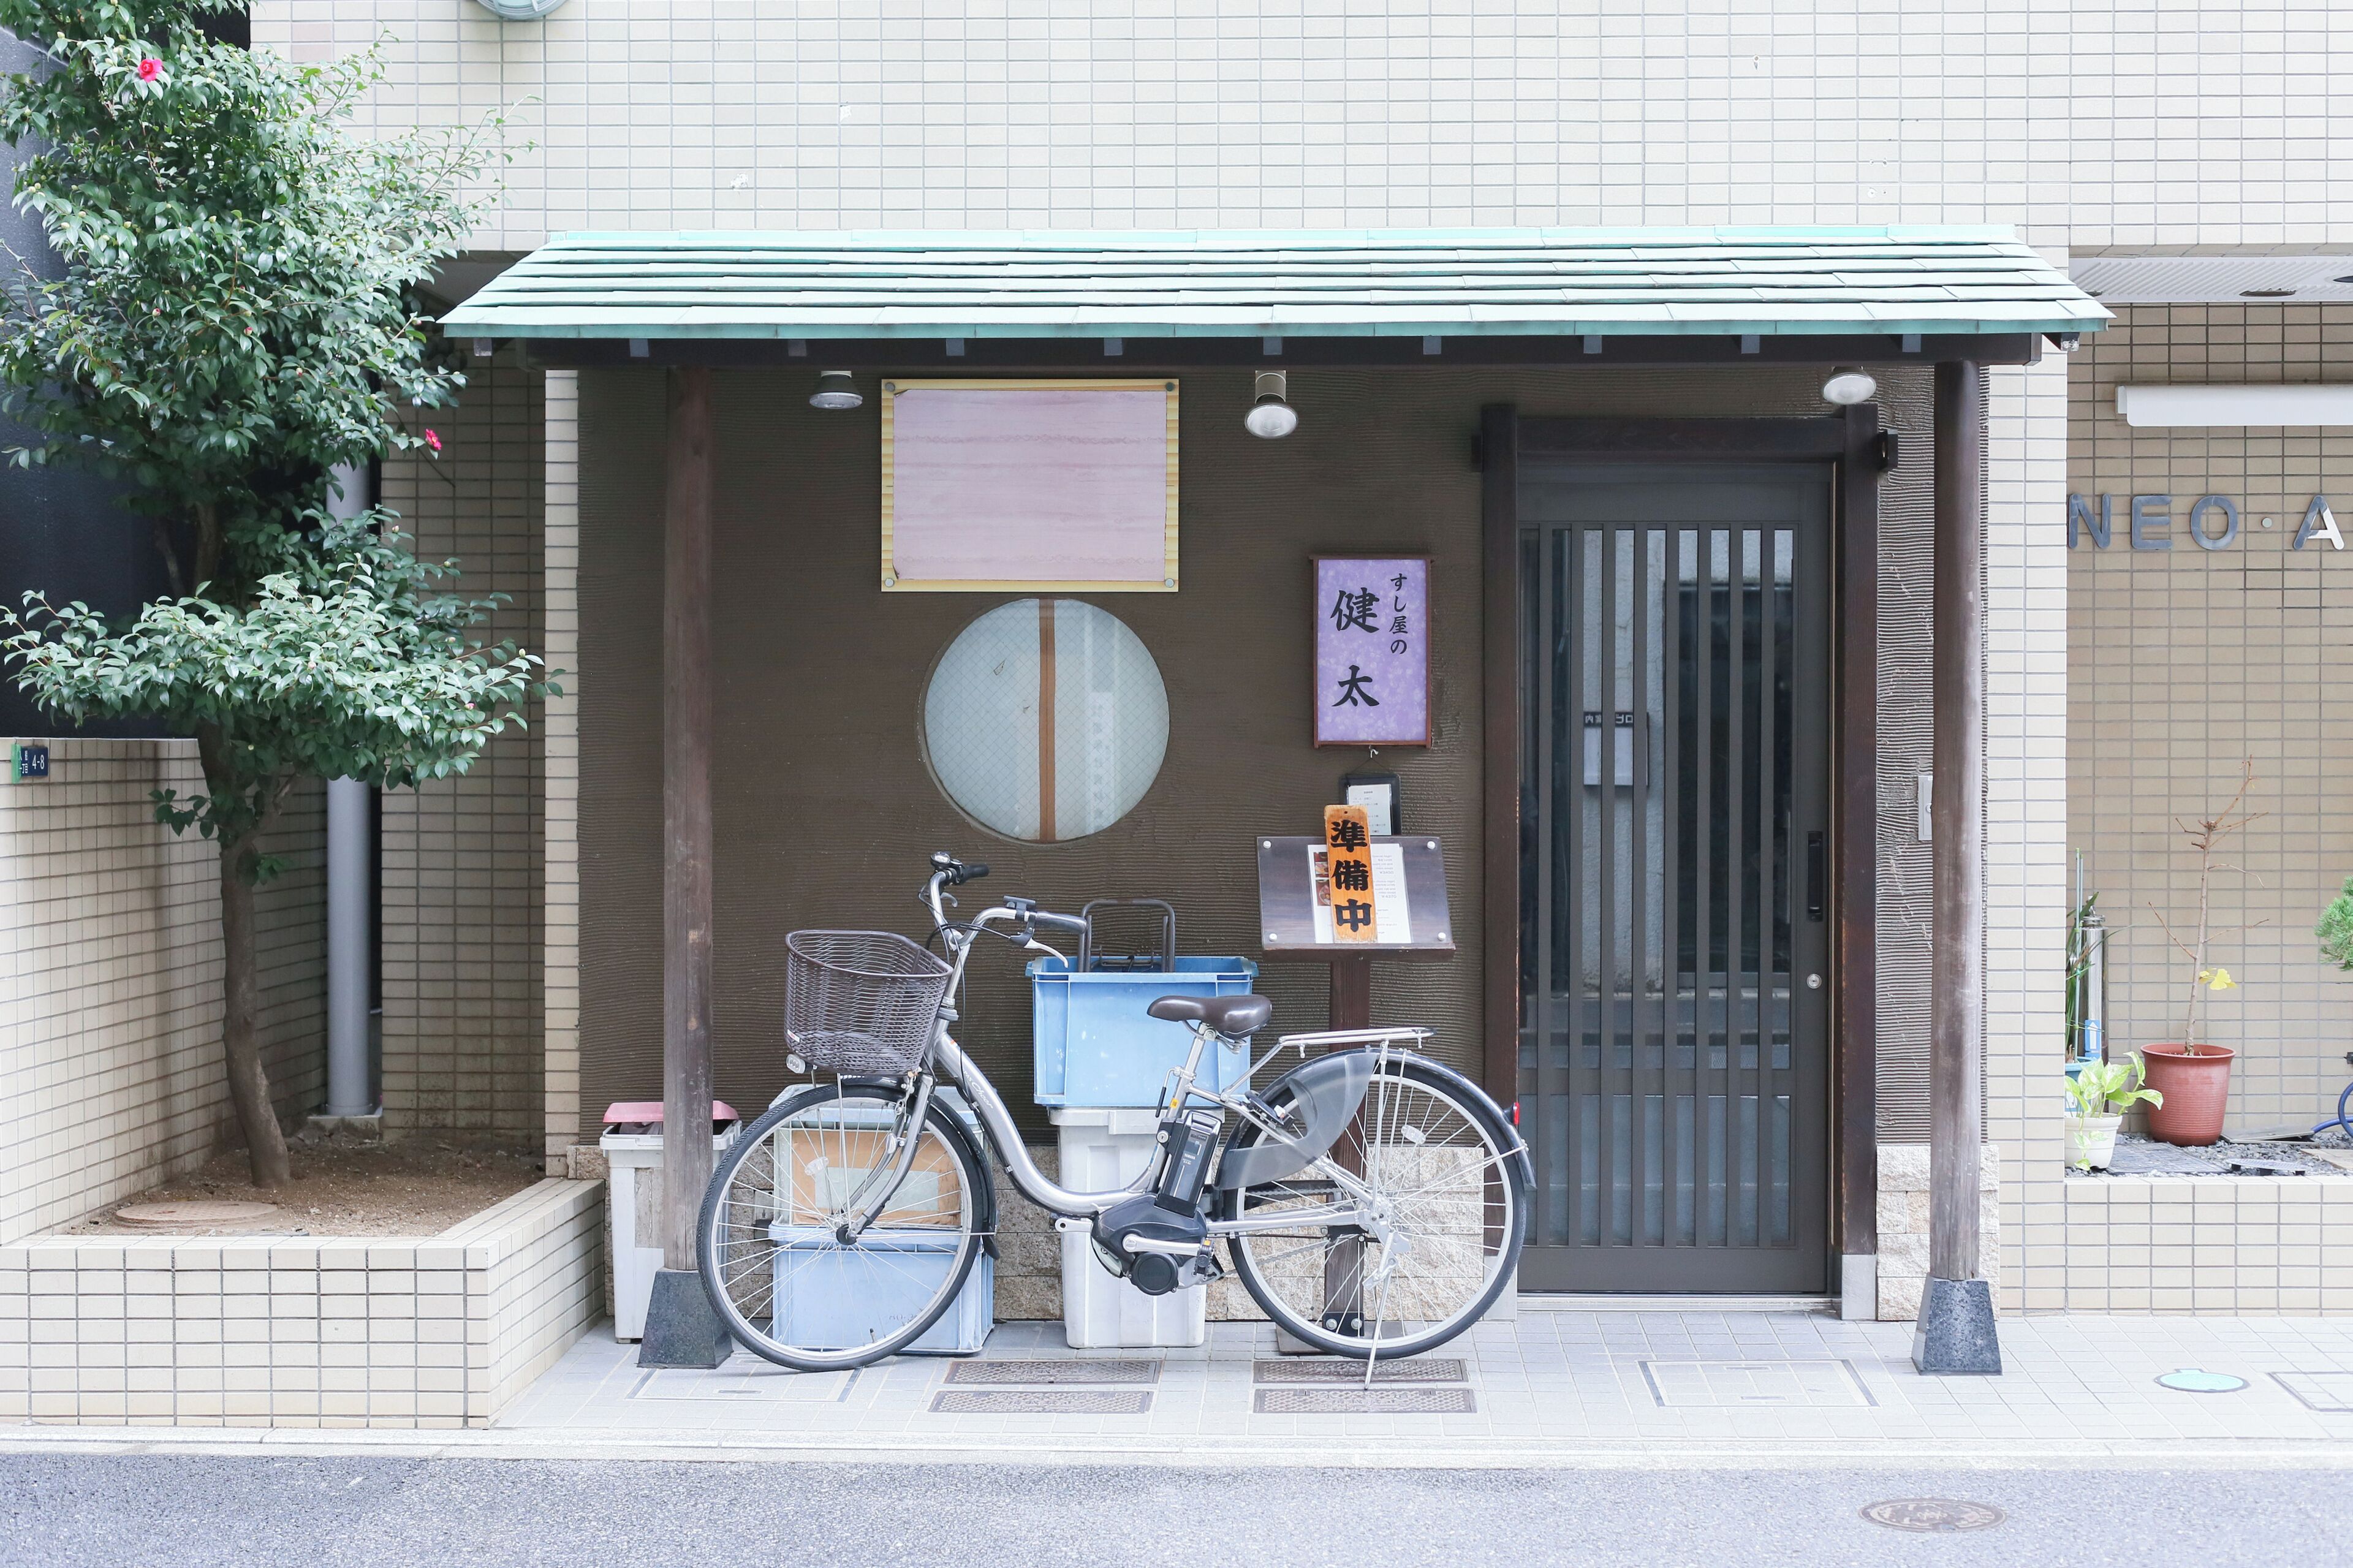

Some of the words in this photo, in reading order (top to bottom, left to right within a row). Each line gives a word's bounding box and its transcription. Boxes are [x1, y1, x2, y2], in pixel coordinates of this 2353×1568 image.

[1330, 587, 1380, 707] 健太
[1389, 573, 1409, 654] すし屋の
[32, 754, 45, 770] 4-8
[1330, 819, 1373, 932] 準備中
[972, 1082, 994, 1108] Cheer
